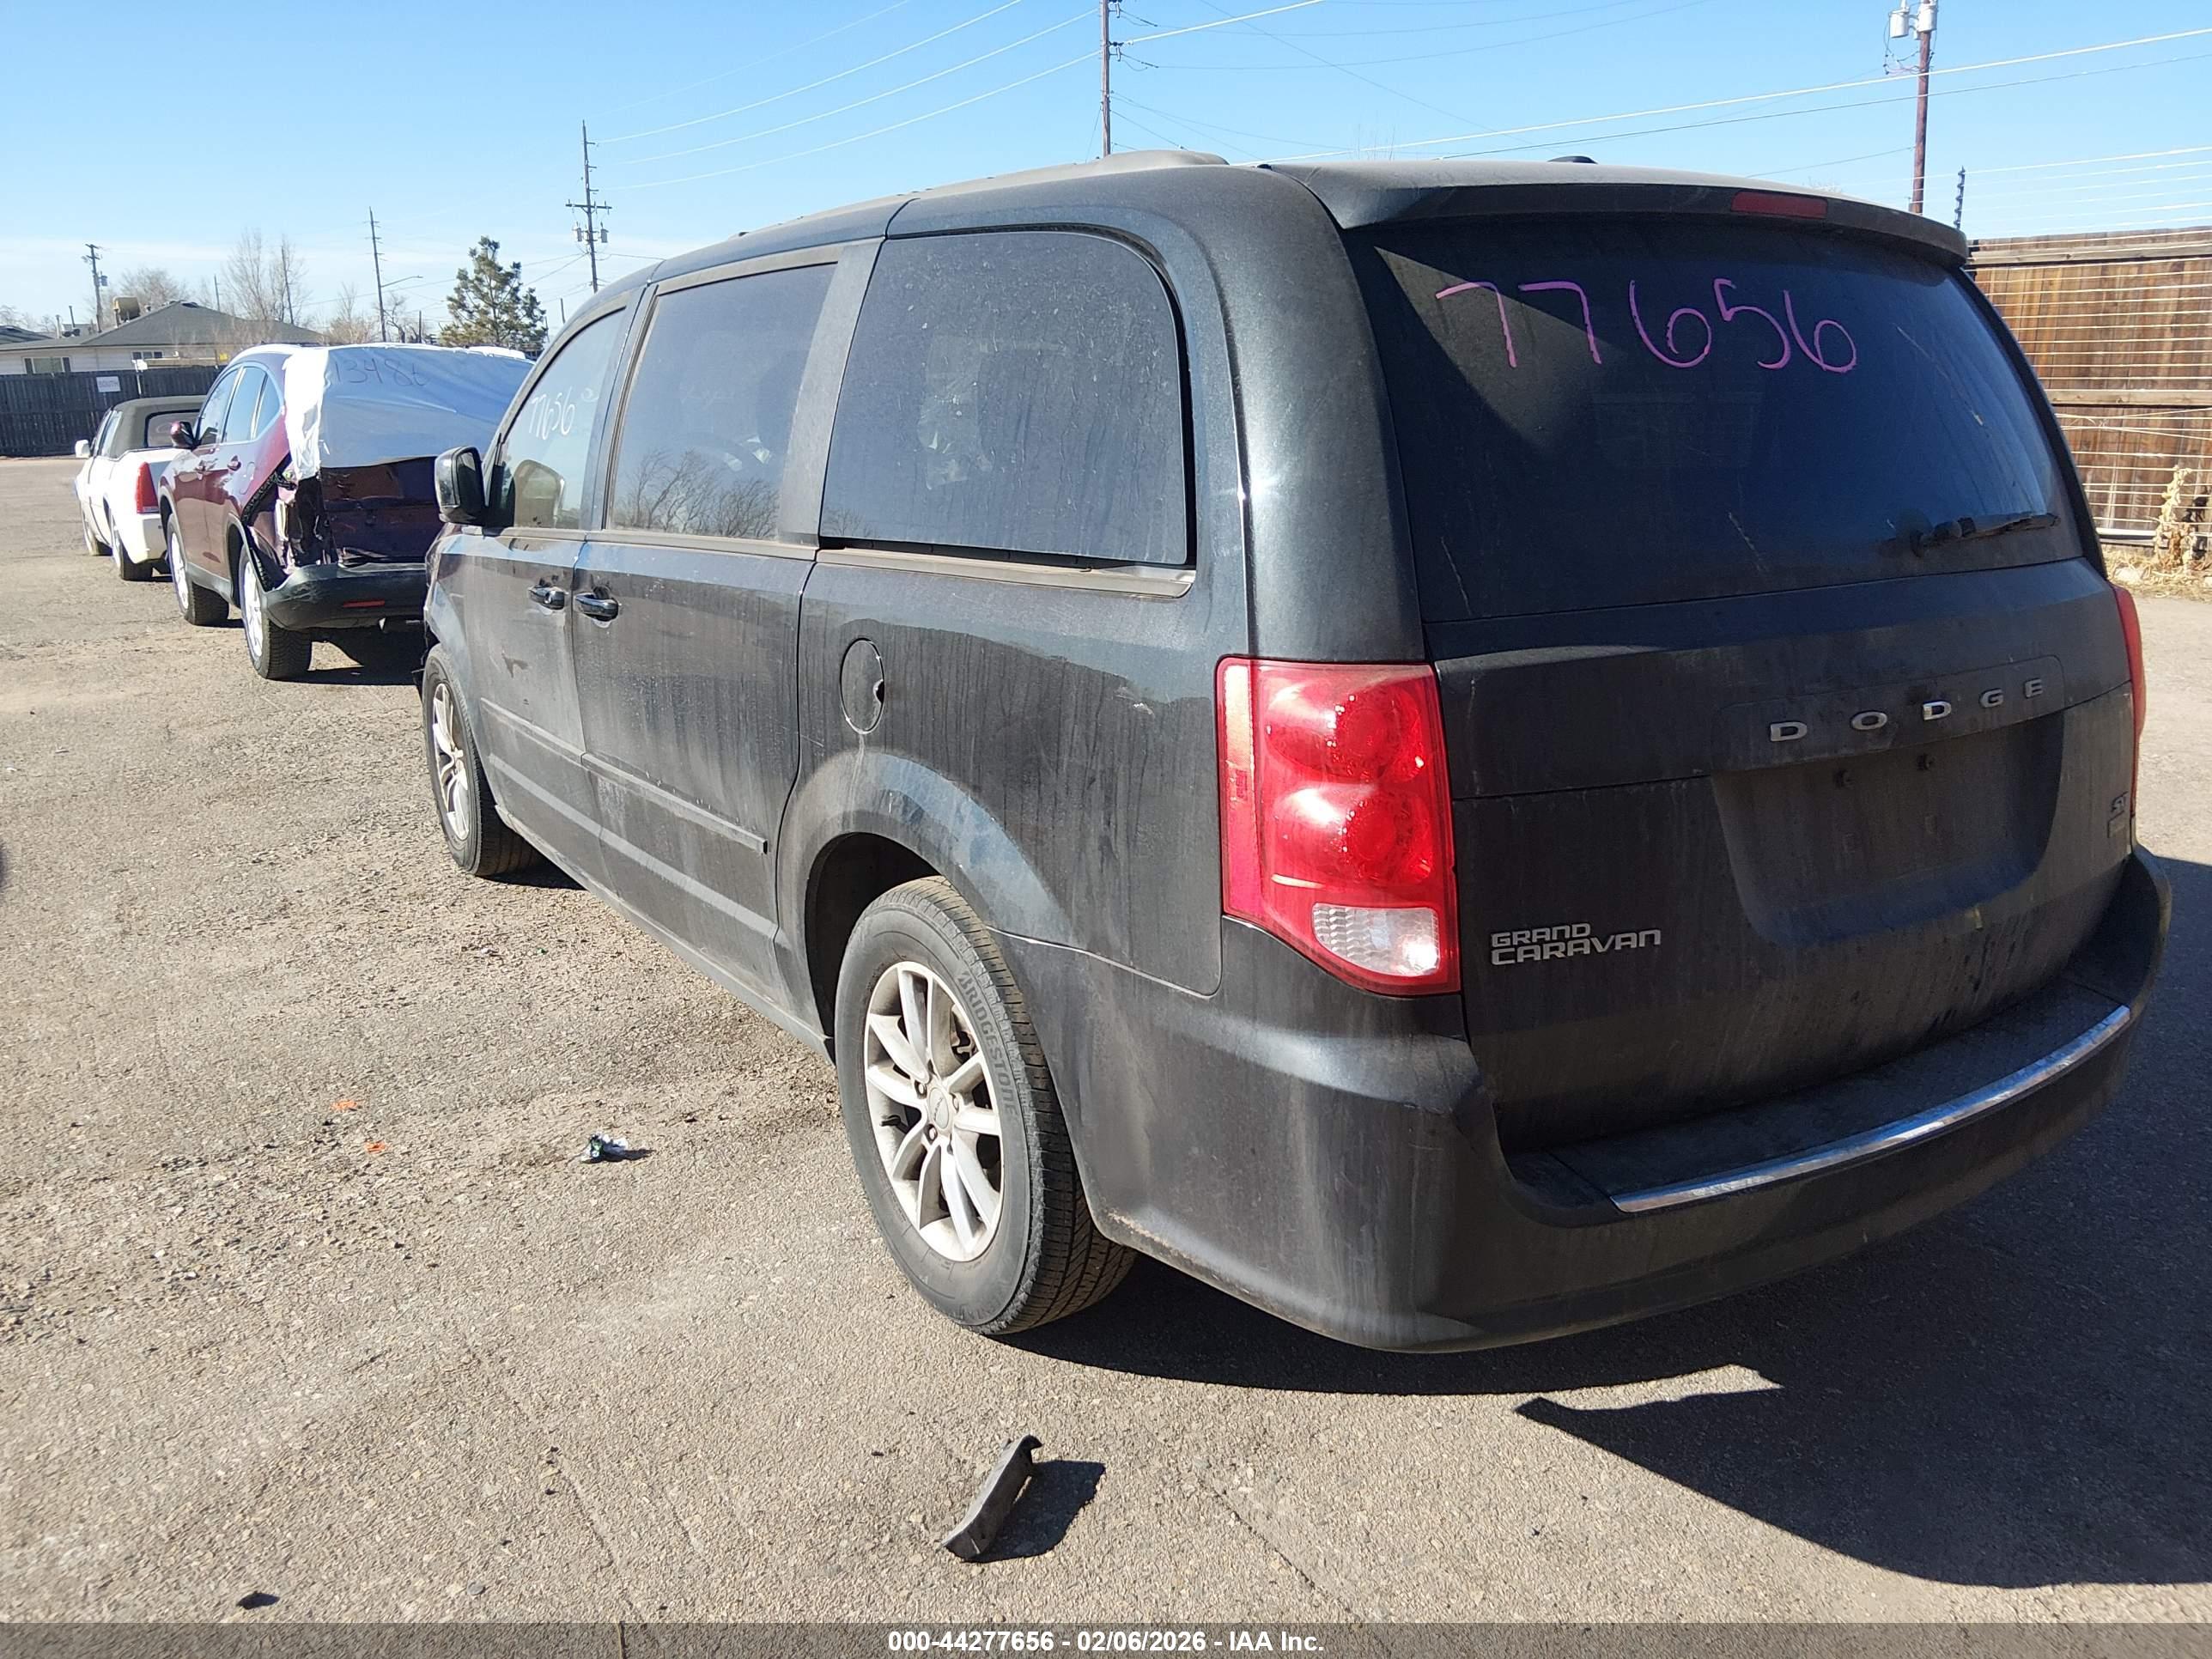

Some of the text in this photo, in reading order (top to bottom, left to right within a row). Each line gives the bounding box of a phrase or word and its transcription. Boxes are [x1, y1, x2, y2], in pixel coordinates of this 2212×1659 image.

[1436, 278, 1856, 373] 77656
[1770, 678, 2044, 742] DODGE
[1491, 922, 1591, 948] GRAND
[1491, 929, 1662, 965] CARAVAN
[957, 970, 1018, 1121] BRIDGESTONE
